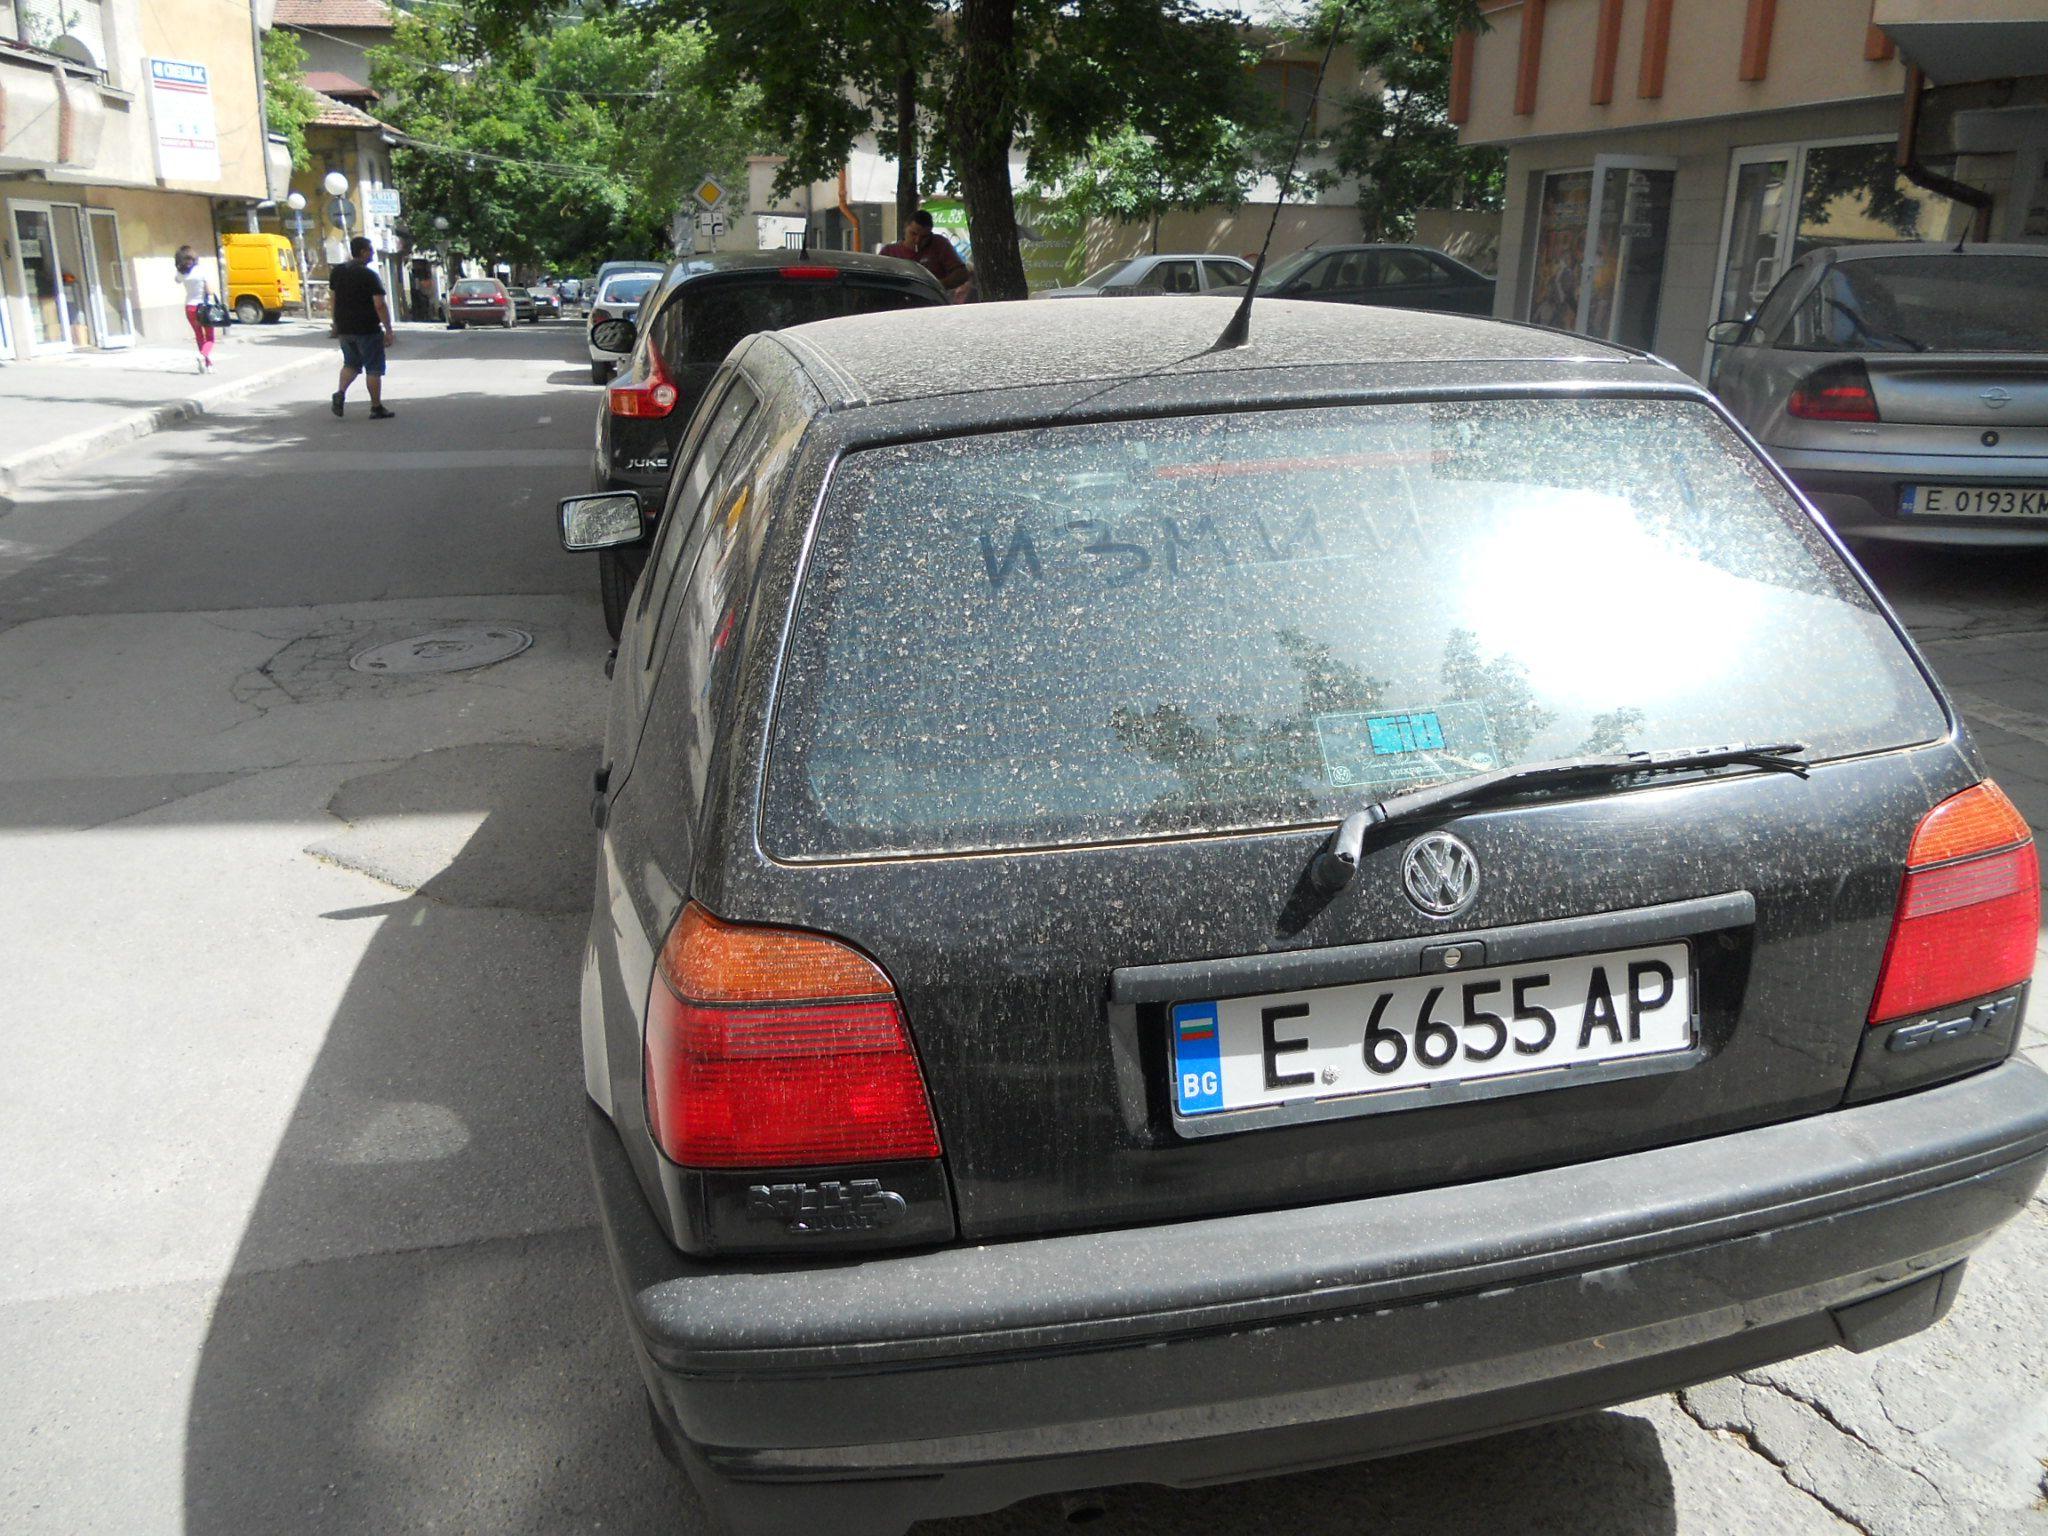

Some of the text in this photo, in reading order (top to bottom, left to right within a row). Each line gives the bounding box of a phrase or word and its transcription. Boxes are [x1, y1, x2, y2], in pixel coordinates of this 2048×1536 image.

[626, 458, 668, 469] JUKE
[1925, 490, 1942, 511] E
[1261, 959, 1675, 1091] E 6655 AP
[1182, 1069, 1218, 1100] BG
